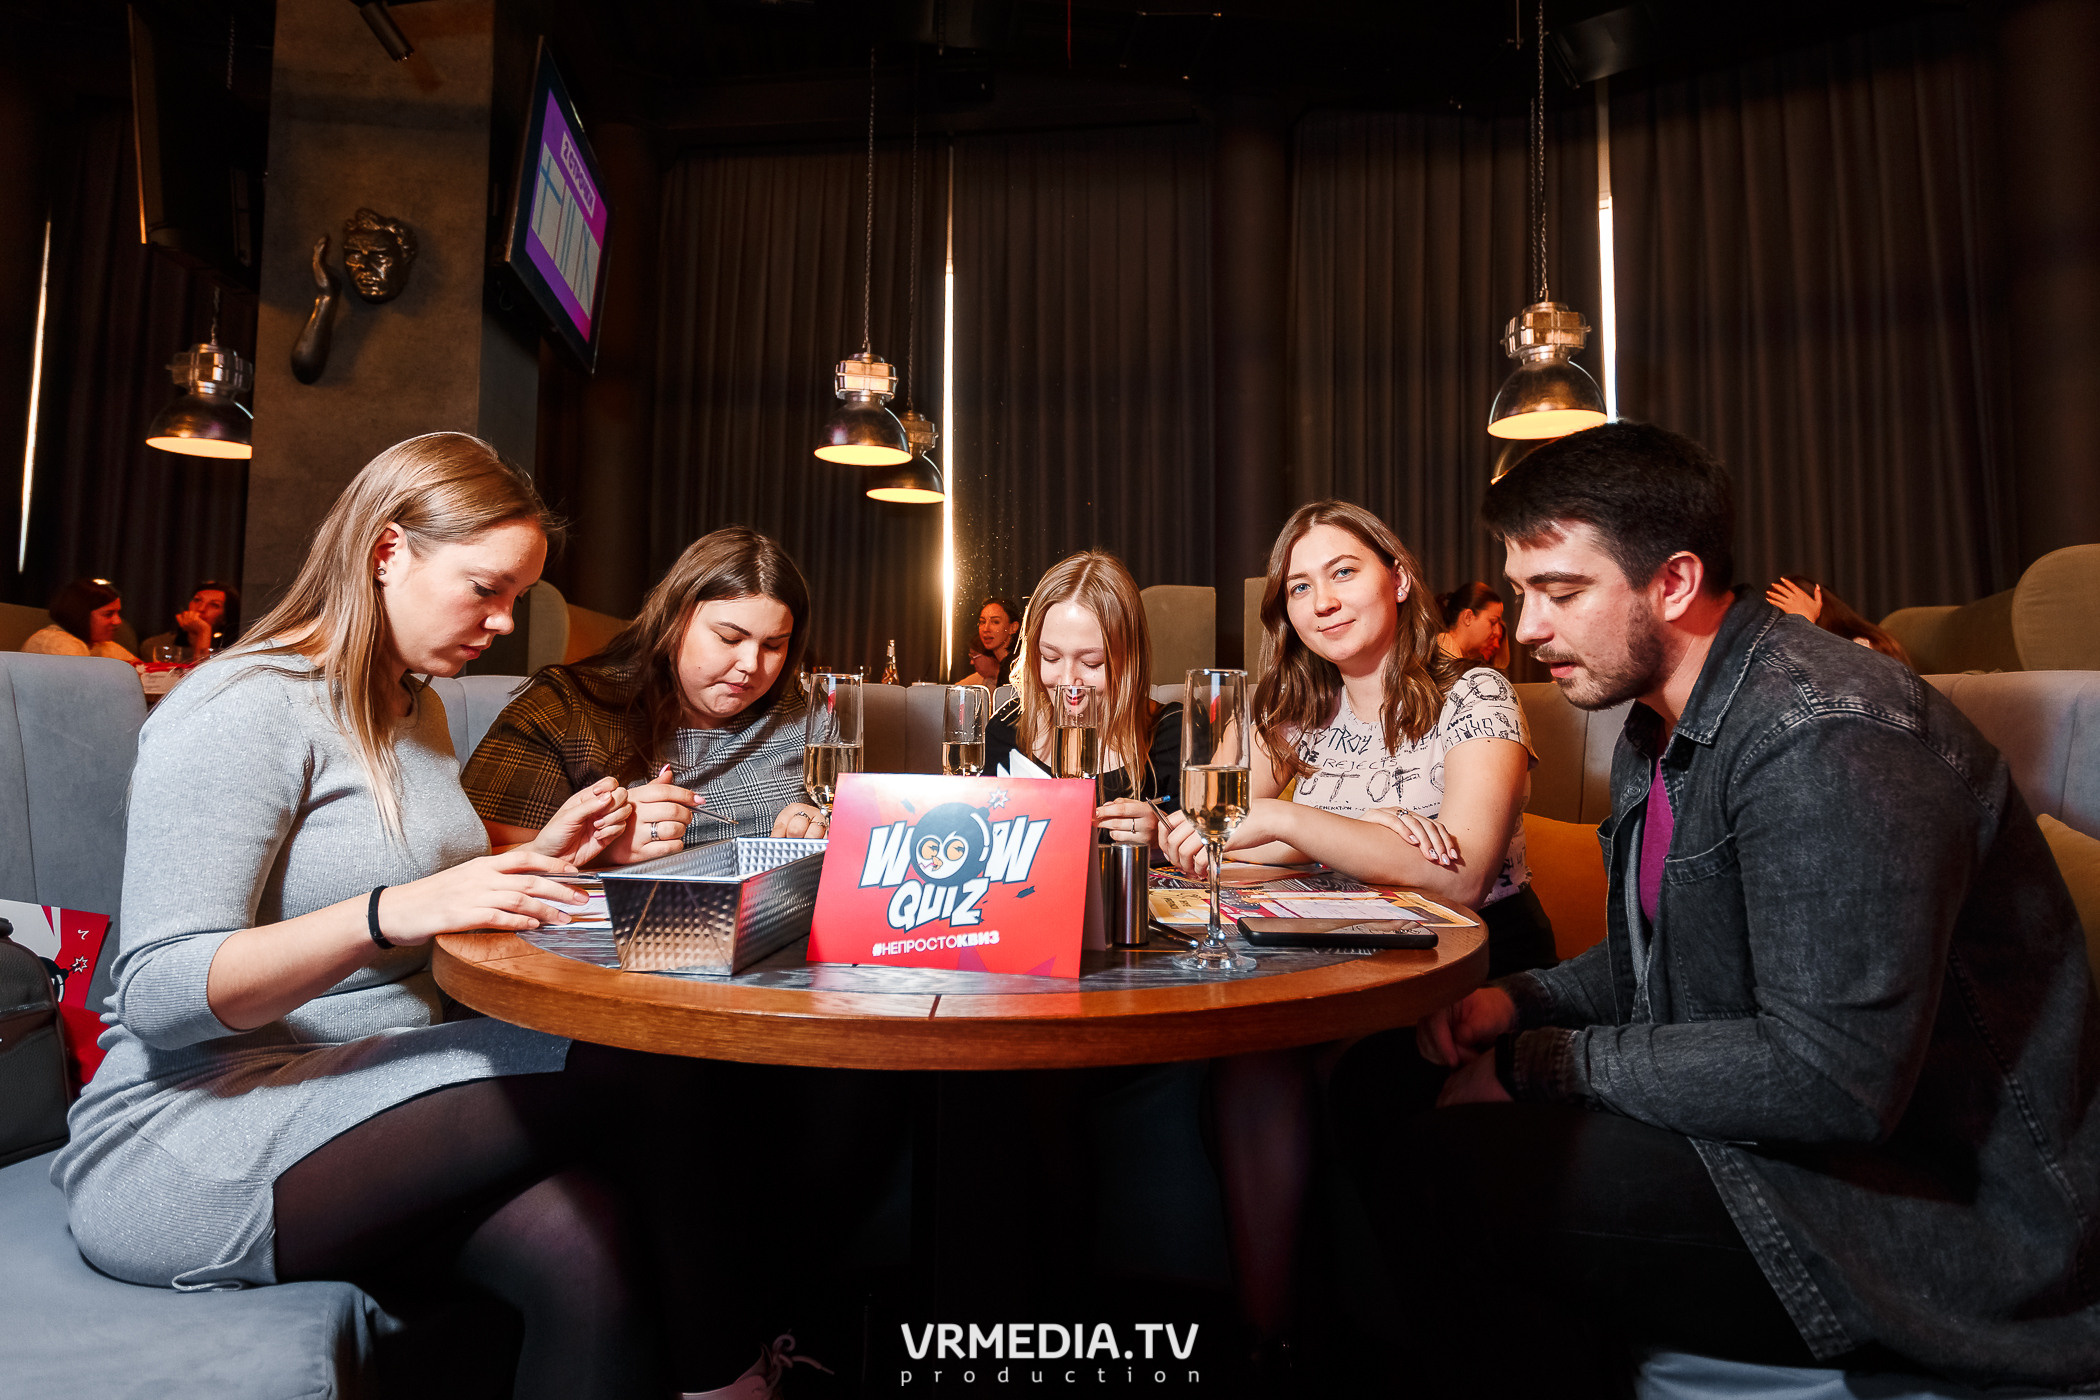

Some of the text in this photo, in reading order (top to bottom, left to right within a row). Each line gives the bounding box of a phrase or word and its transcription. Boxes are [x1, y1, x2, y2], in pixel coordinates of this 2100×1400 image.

[858, 803, 1052, 889] WOW
[887, 877, 991, 933] QUIZ
[872, 930, 1000, 957] #НЕПРОСТОКВИЗ
